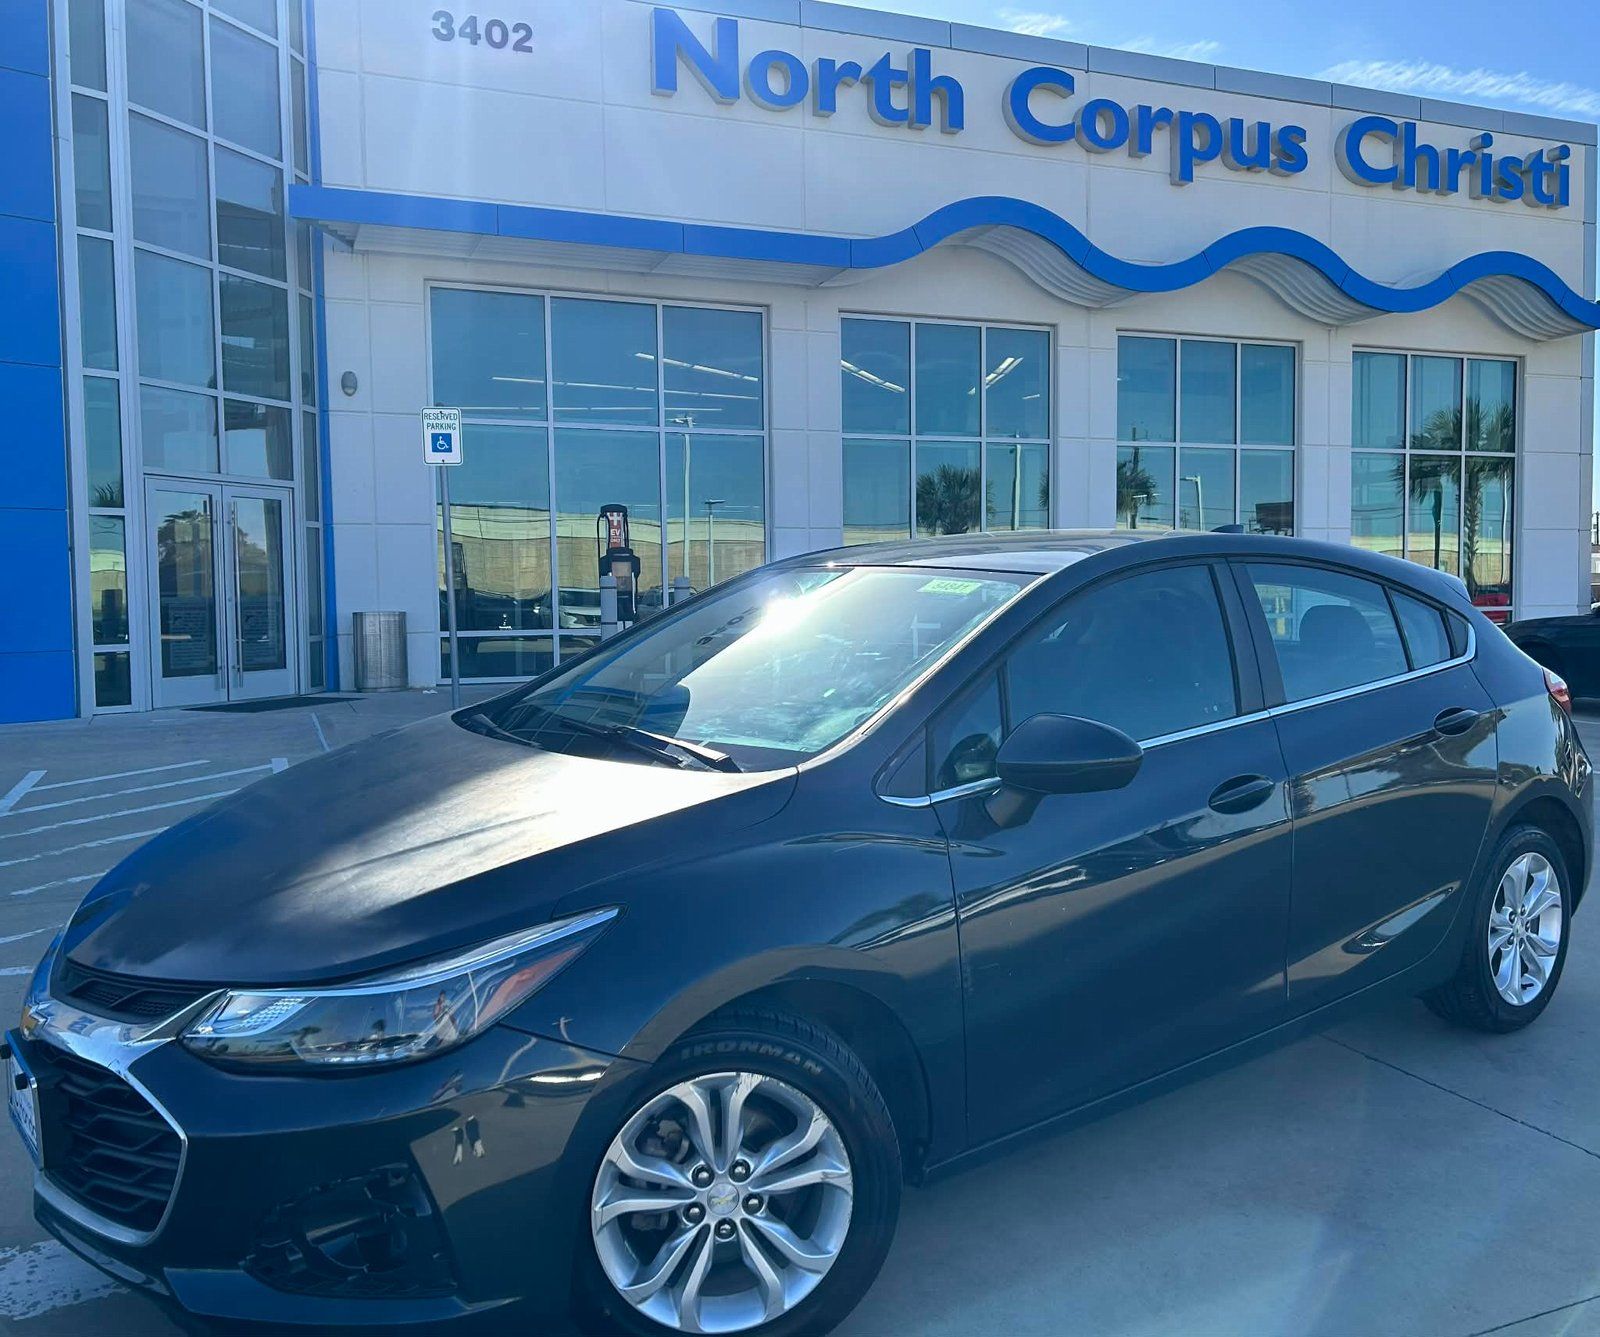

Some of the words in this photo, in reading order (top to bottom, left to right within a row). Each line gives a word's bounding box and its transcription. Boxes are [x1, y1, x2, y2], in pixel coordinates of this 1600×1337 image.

[431, 10, 533, 53] 3402
[651, 7, 964, 134] North
[1002, 66, 1308, 186] Corpus
[1336, 115, 1570, 209] Christi
[424, 412, 458, 421] RESERVED
[426, 422, 457, 431] PARKING
[610, 528, 621, 536] EV
[682, 1041, 822, 1075] IRONMAN
